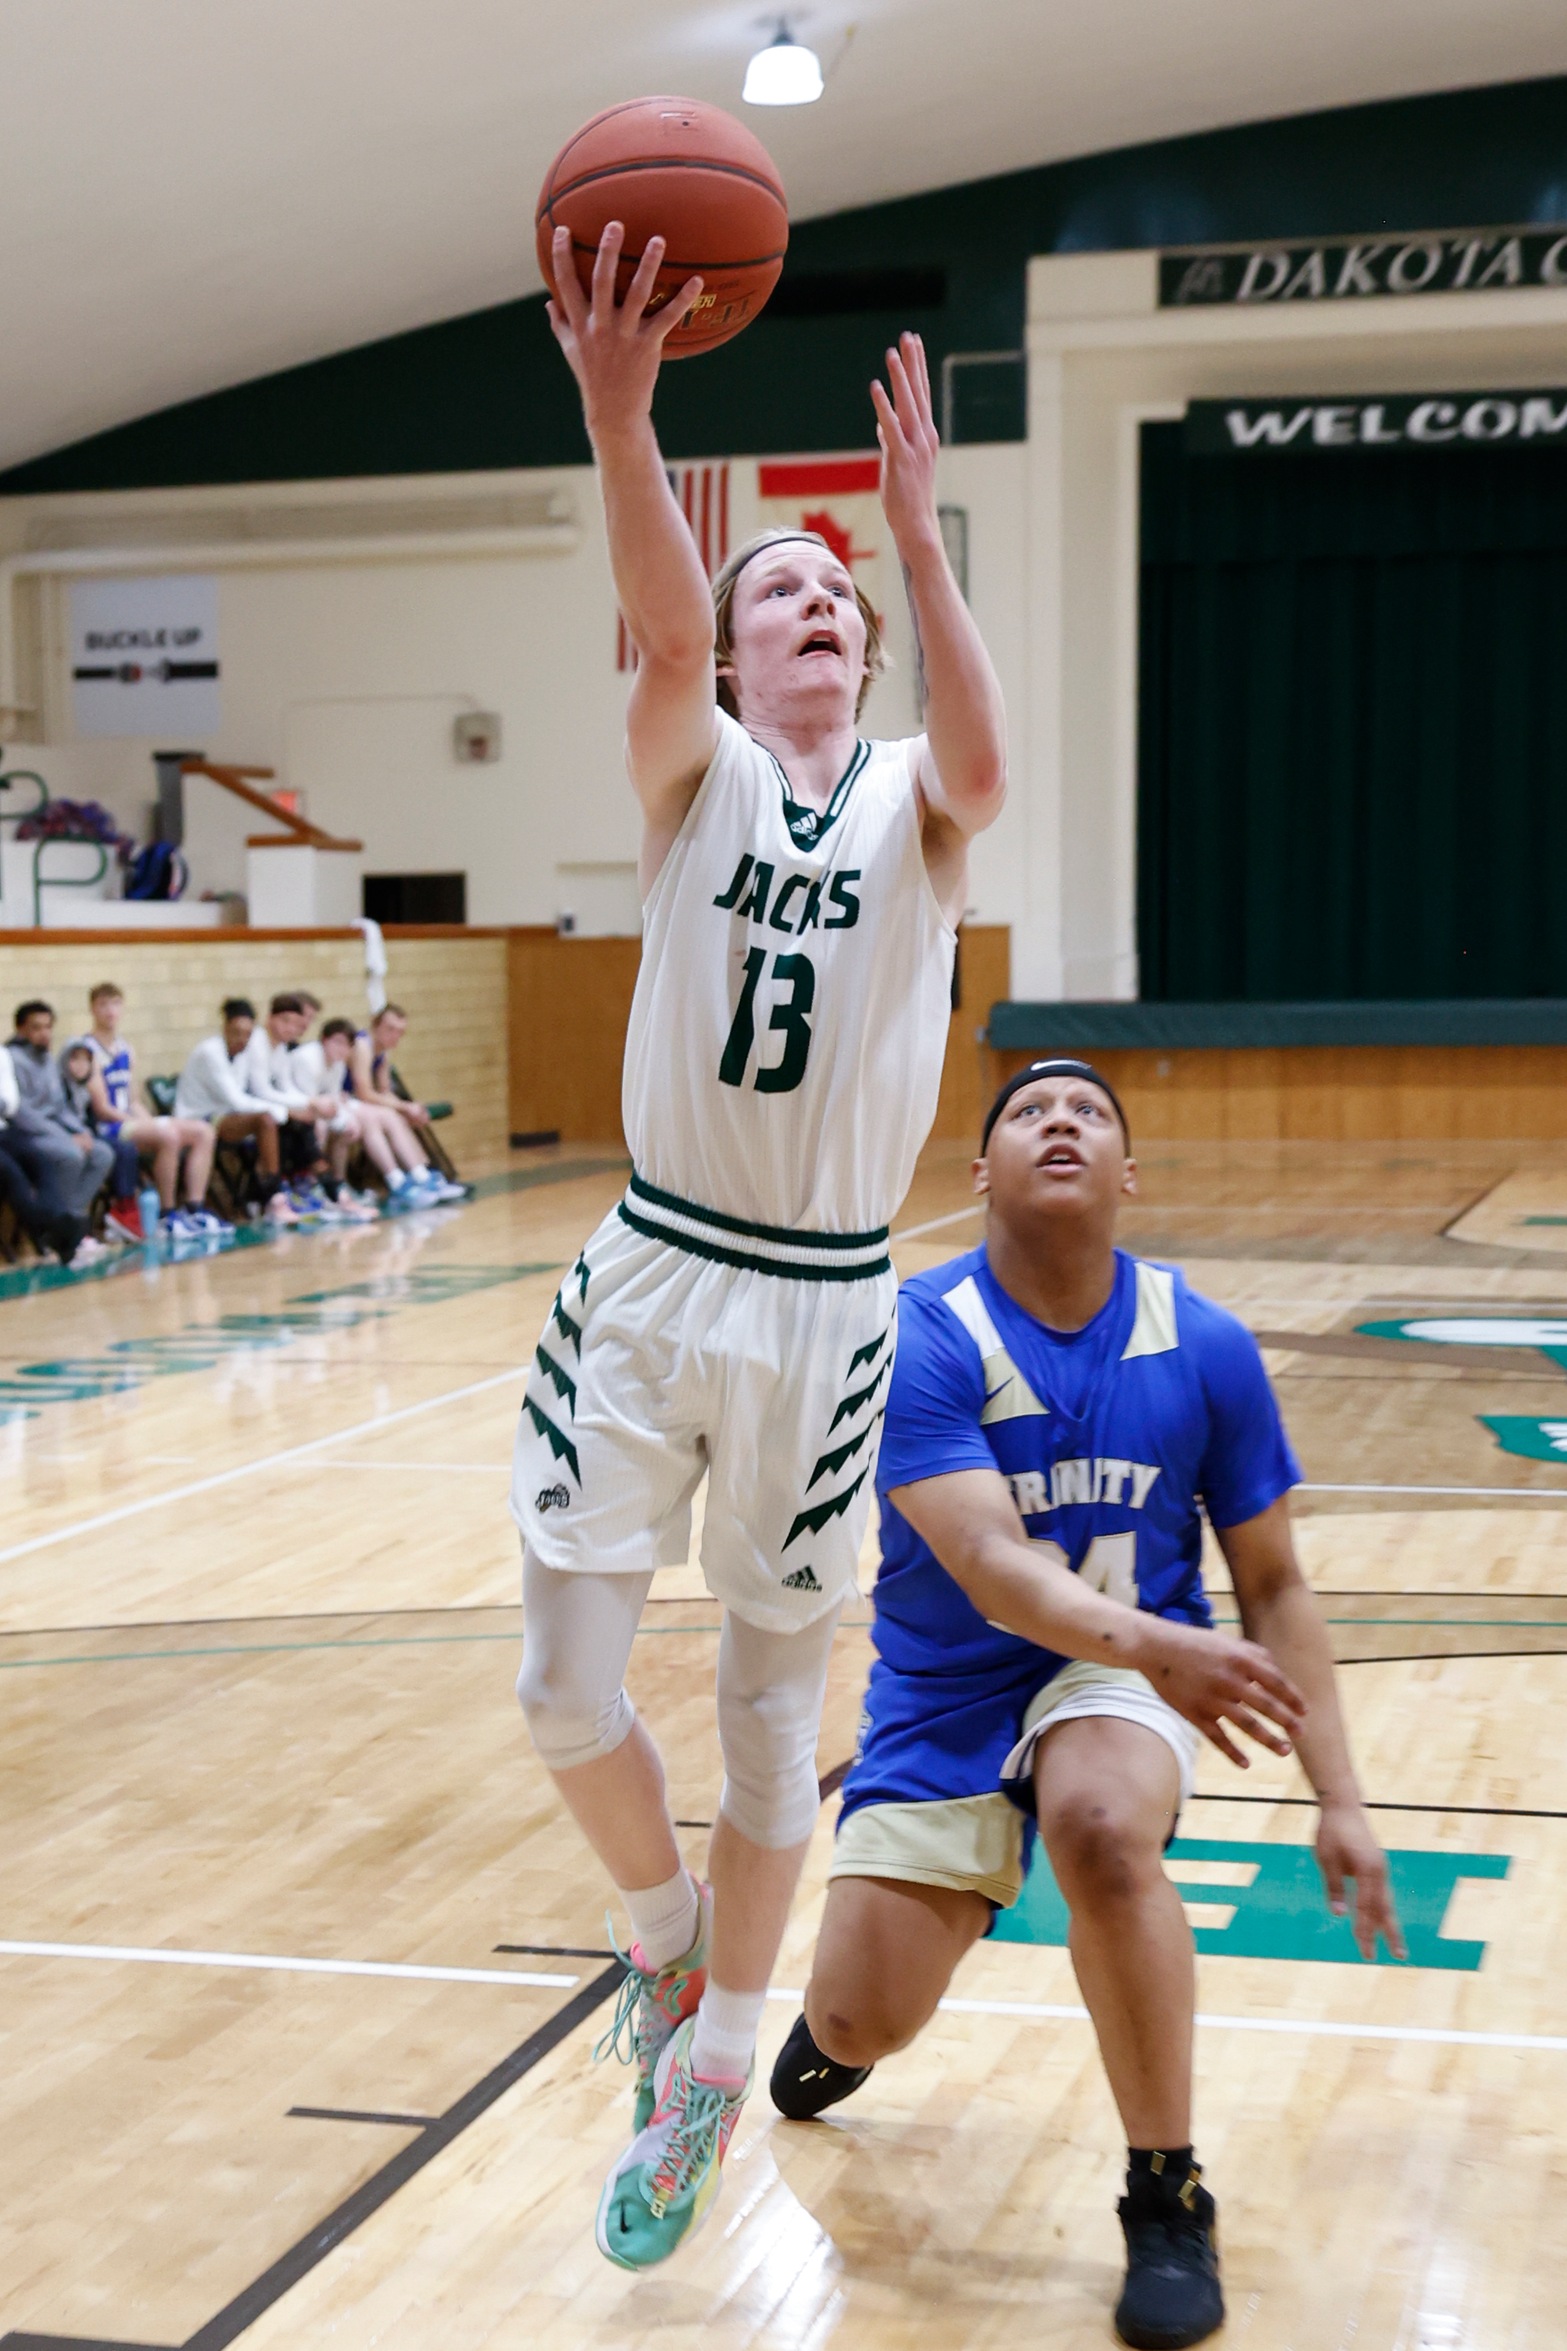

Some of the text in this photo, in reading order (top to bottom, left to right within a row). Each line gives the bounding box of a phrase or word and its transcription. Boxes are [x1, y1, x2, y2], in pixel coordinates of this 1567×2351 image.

[1237, 236, 1523, 300] DAKOTA
[85, 627, 202, 650] BUCKLE UP
[712, 853, 862, 936] JACKS
[718, 946, 816, 1093] 13
[1007, 1457, 1162, 1516] RINITY
